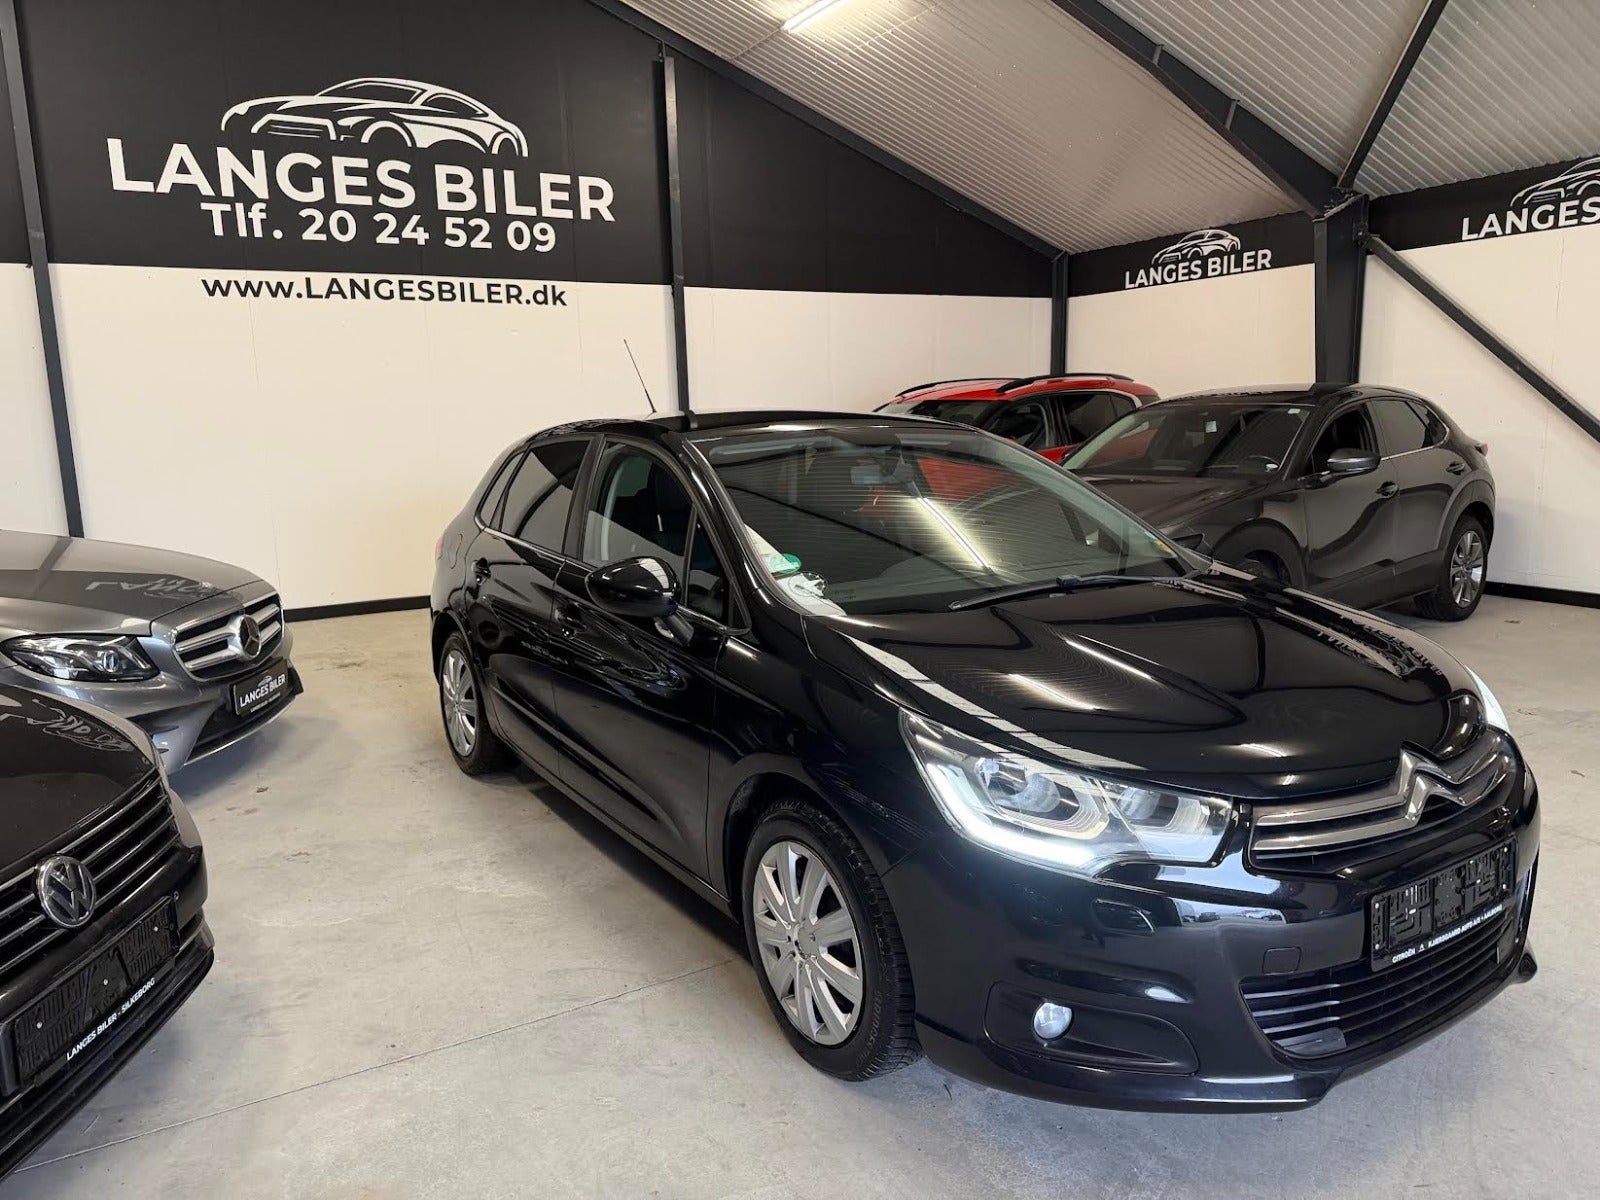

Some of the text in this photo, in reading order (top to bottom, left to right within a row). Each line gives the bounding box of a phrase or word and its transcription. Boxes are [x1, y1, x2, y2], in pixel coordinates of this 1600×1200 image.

[106, 137, 616, 222] LANGES BILER
[200, 202, 556, 253] Tlf. 20 24 52 09
[1461, 196, 1600, 241] LANGES
[201, 276, 567, 306] www.LANGESBILER.dk
[1124, 248, 1272, 290] LANGES BILER
[240, 685, 269, 707] LANGES
[269, 674, 286, 691] BILER
[66, 1030, 97, 1061] LANGES
[97, 1012, 118, 1035] BILER
[121, 977, 156, 1014] SILKEBORG
